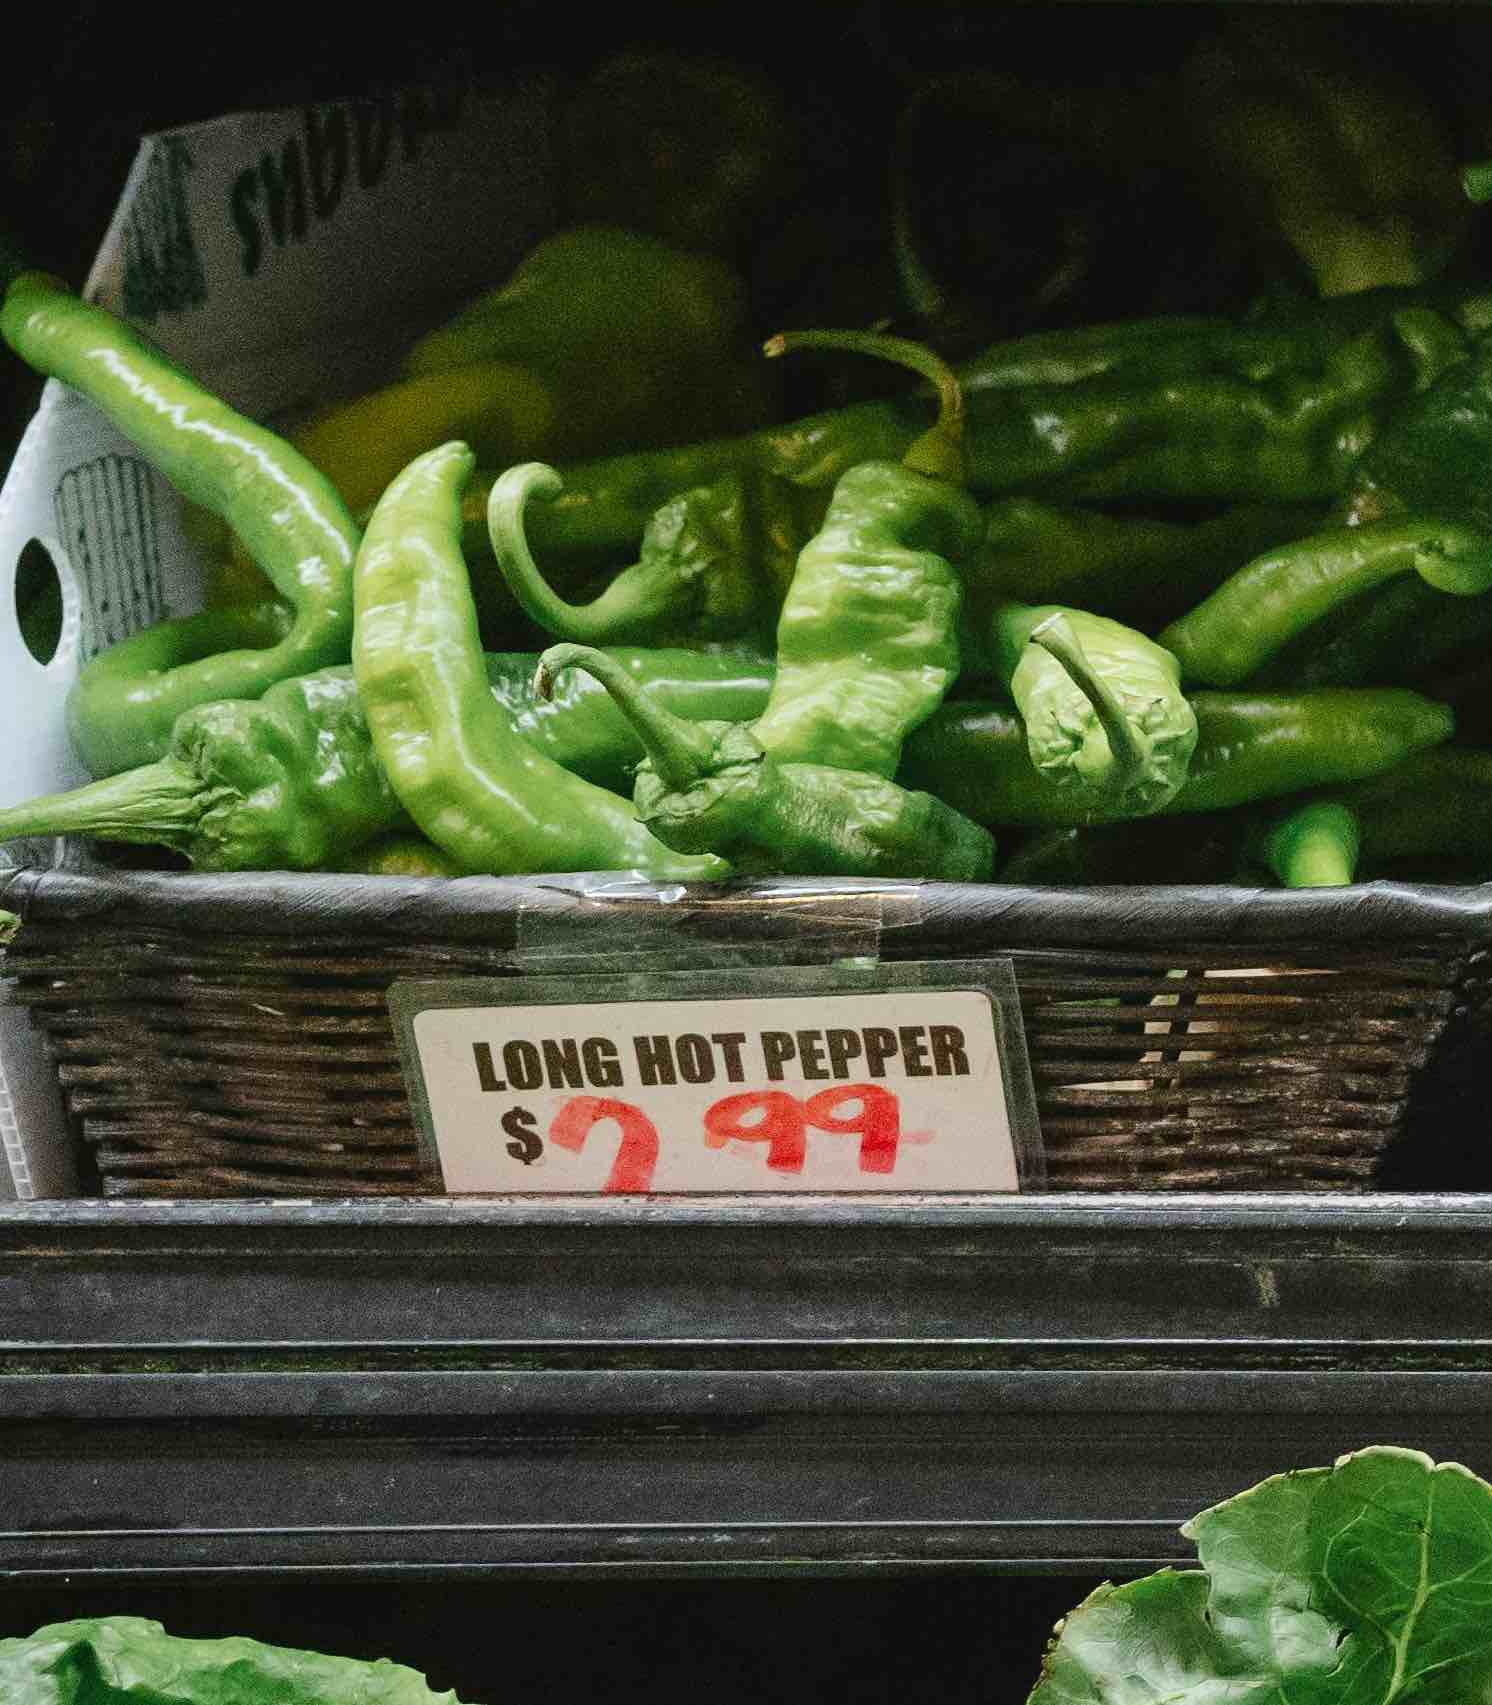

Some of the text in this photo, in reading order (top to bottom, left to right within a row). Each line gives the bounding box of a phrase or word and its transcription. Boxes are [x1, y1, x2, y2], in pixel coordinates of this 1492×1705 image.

[472, 1024, 972, 1093] LONG HOT PEPPER
